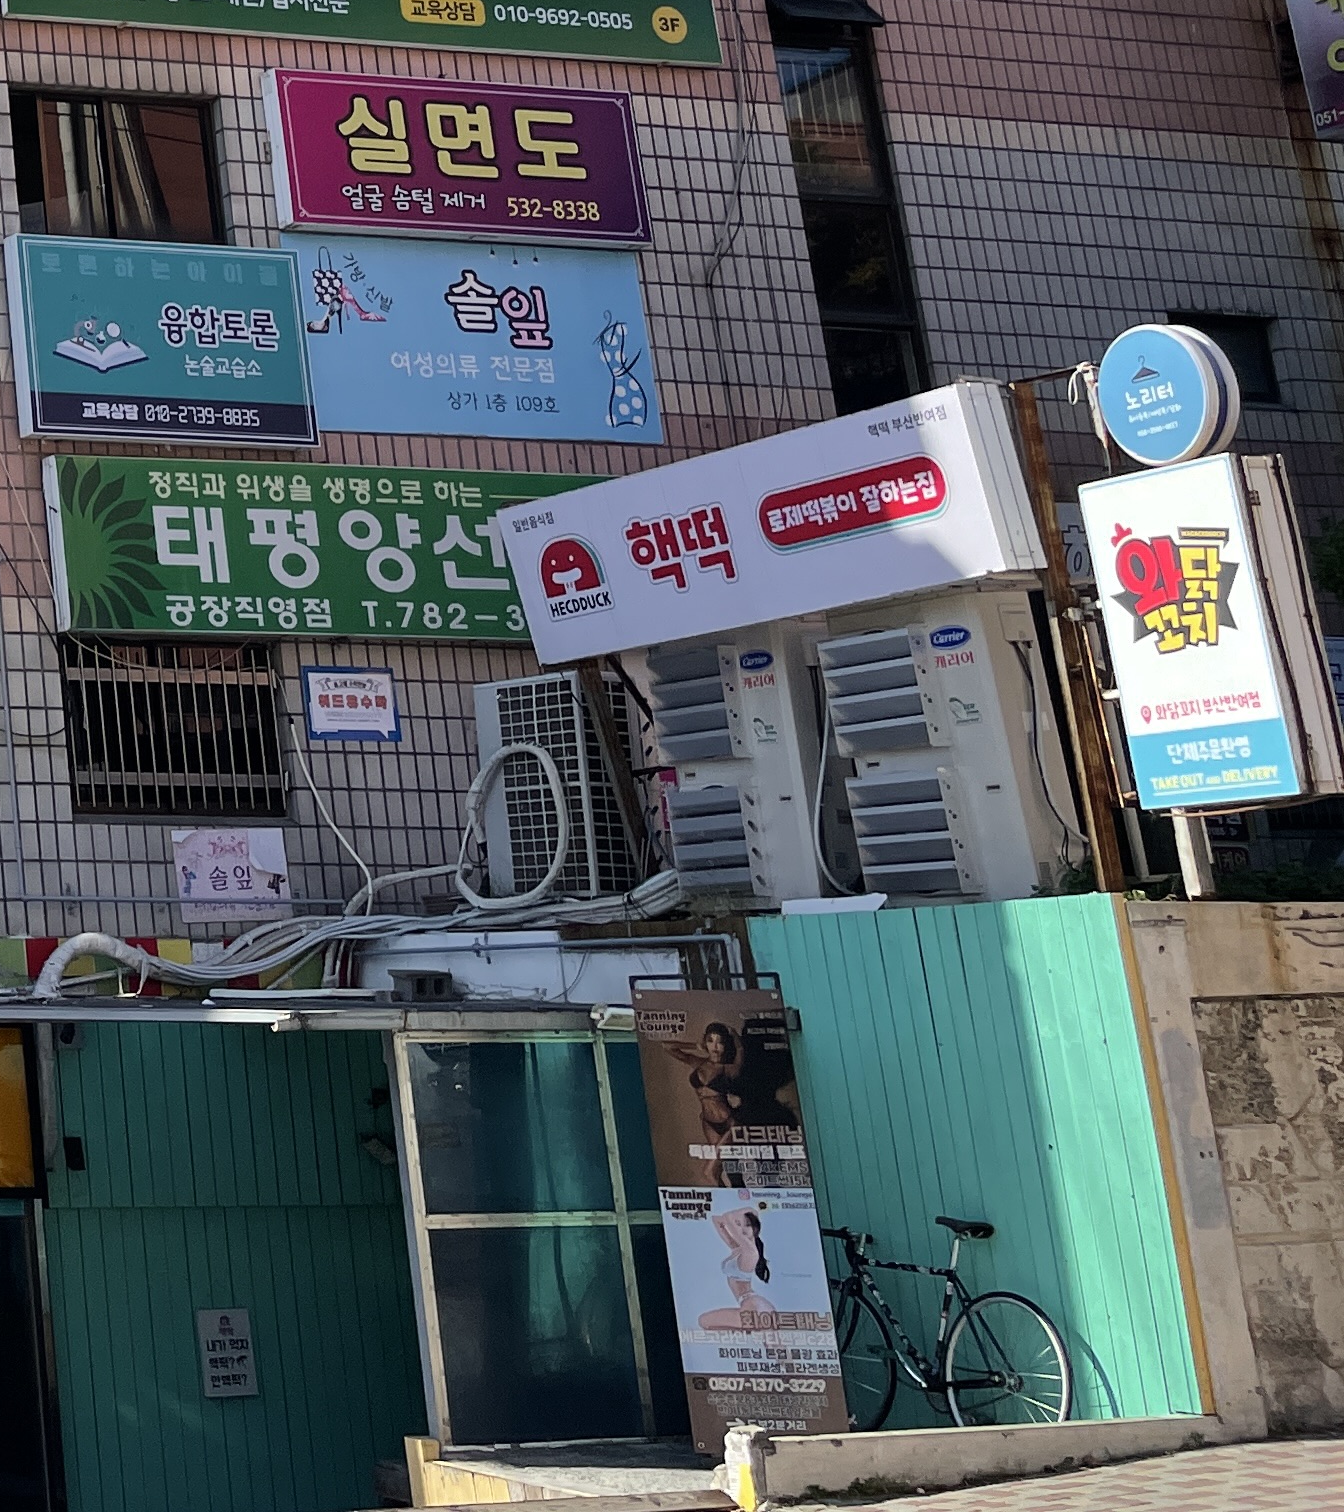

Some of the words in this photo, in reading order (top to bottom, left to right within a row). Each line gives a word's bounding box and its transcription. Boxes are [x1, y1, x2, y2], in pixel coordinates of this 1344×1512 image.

[409, 0, 477, 22] 교육상담
[493, 3, 634, 31] 010-9692-0505
[658, 15, 681, 33] 3F
[337, 96, 589, 183] 실면도
[439, 190, 485, 212] 제거
[507, 196, 600, 222] 532-8338
[444, 270, 553, 349] 솔잎
[159, 302, 279, 352] 융합토론
[184, 354, 262, 378] 논술교습소
[390, 352, 480, 380] 여성의류
[490, 355, 555, 384] 전문점
[447, 392, 478, 411] 상가
[486, 394, 507, 412] 1층
[516, 395, 560, 413] 109호
[1125, 381, 1174, 411] 노리터
[82, 402, 139, 420] 교육상담
[149, 470, 226, 499] 정직과
[434, 481, 483, 508] 하는
[859, 471, 937, 513] 잘하는집
[623, 502, 738, 593] 핵떡
[166, 595, 332, 629] 공장직영점
[550, 592, 612, 618] HECDDUCK
[933, 631, 968, 646] Carrier
[933, 651, 974, 669] 캐리어
[743, 673, 775, 689] 캐리어
[637, 1011, 686, 1023] Tanning
[640, 1022, 685, 1034] Lounge
[731, 1125, 803, 1143] 다크태닝
[661, 1189, 712, 1202] Tanning
[740, 1311, 832, 1331] 화이트태닝
[709, 1377, 826, 1393] 0507-1370-3229
